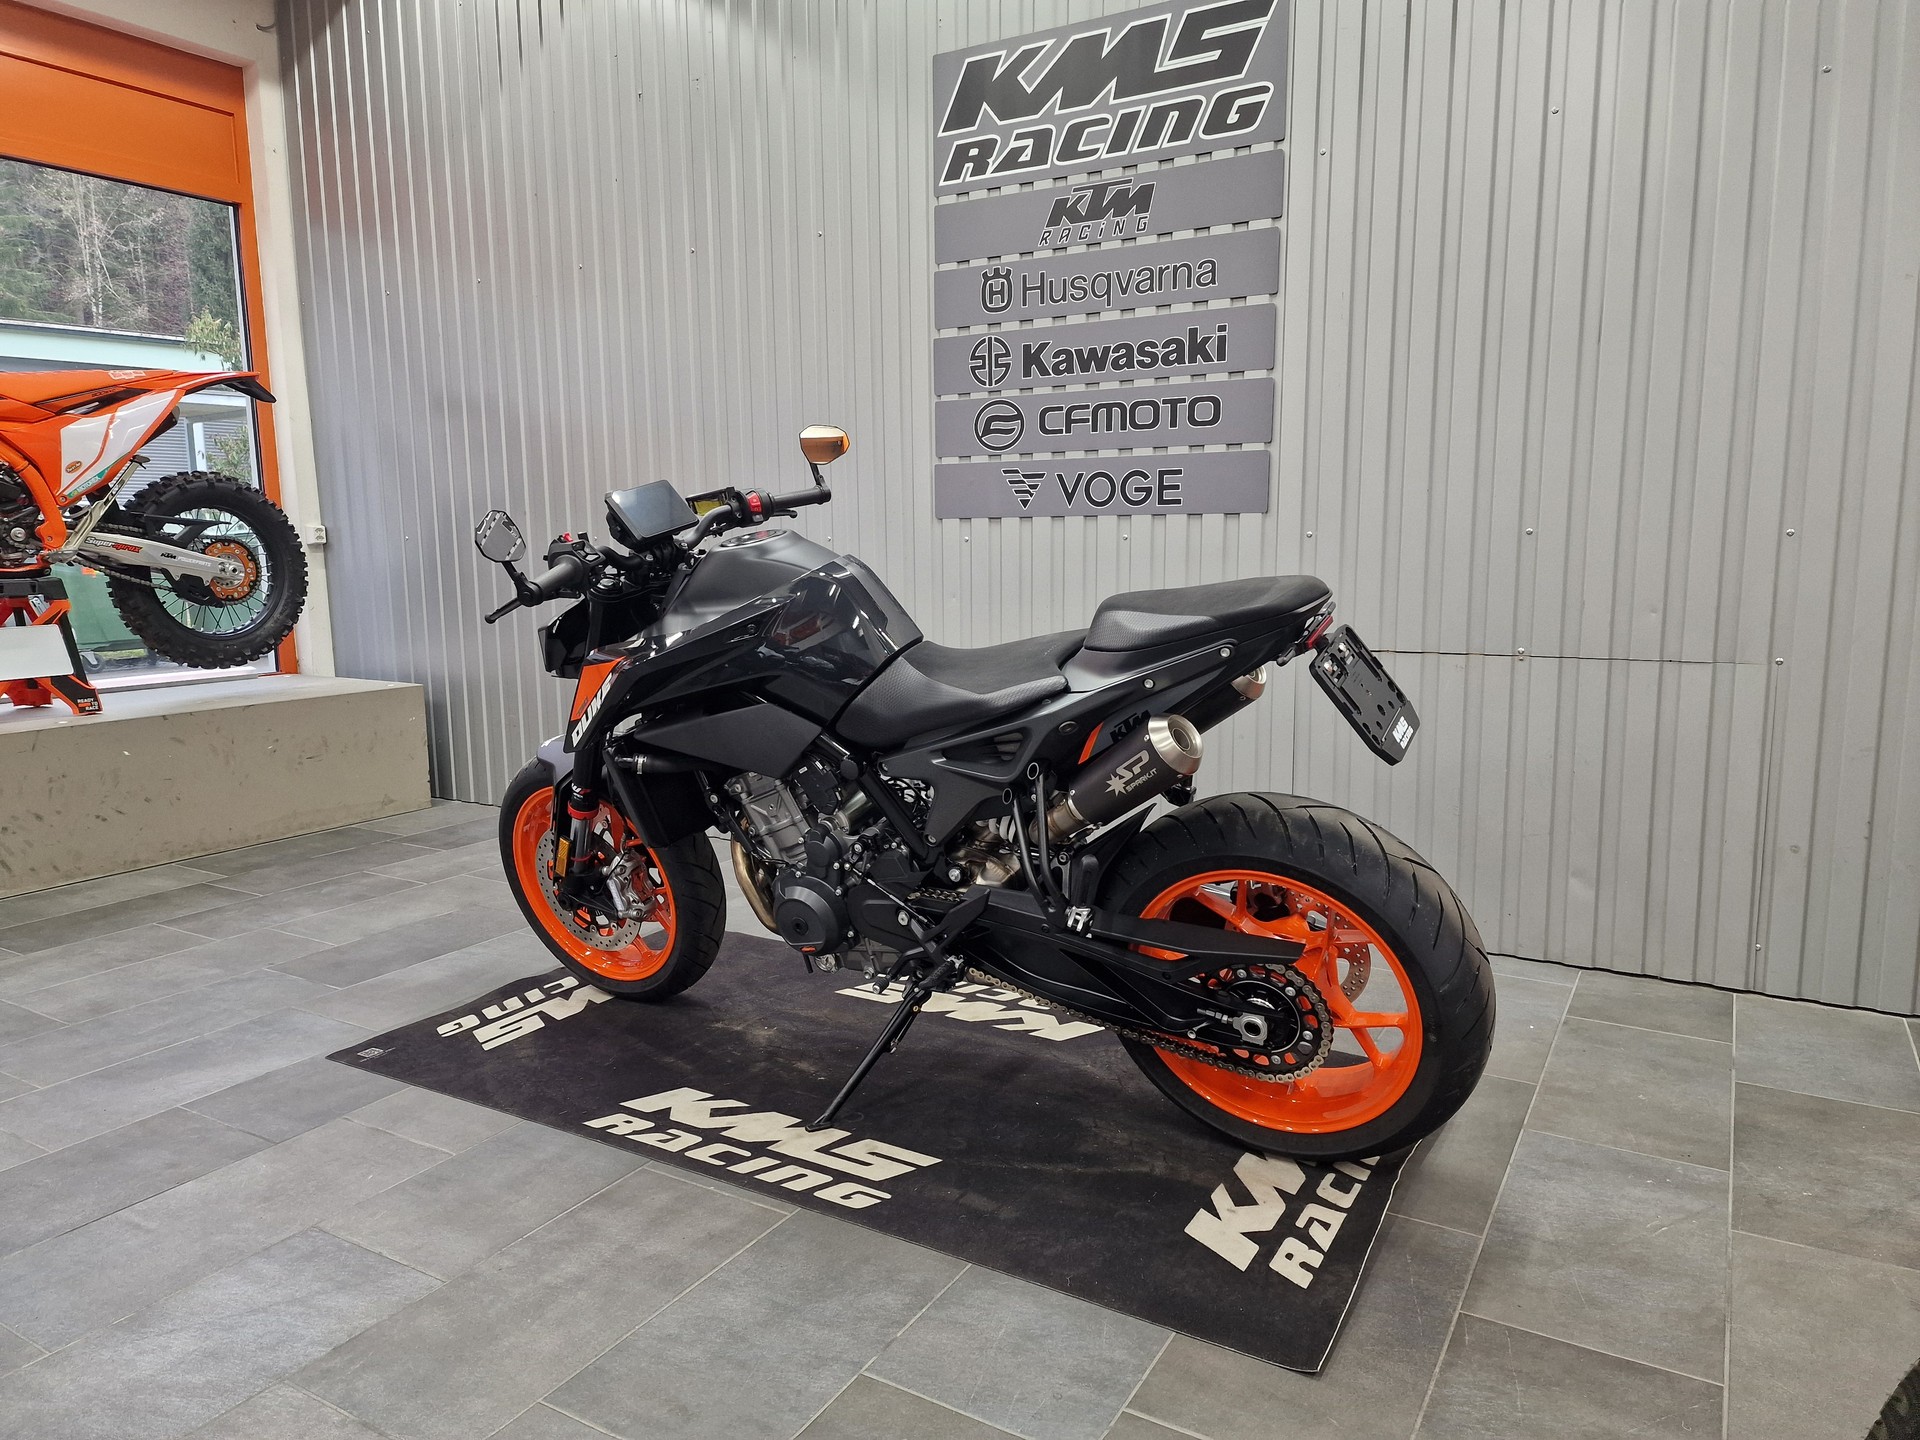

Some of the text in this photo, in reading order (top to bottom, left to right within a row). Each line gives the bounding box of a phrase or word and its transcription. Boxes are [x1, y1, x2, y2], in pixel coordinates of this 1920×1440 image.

[938, 0, 1278, 137] KMS
[938, 81, 1275, 186] RACING
[1044, 178, 1156, 228] KTM
[1020, 257, 1219, 308] Husqvarna
[1020, 323, 1229, 380] Kawasaki
[1037, 394, 1223, 435] CFMOTO
[1055, 467, 1184, 508] VOGE
[571, 672, 616, 748] DUKE
[436, 976, 580, 1038] CING
[583, 1112, 893, 1210] RACING
[619, 1086, 943, 1183] KMS
